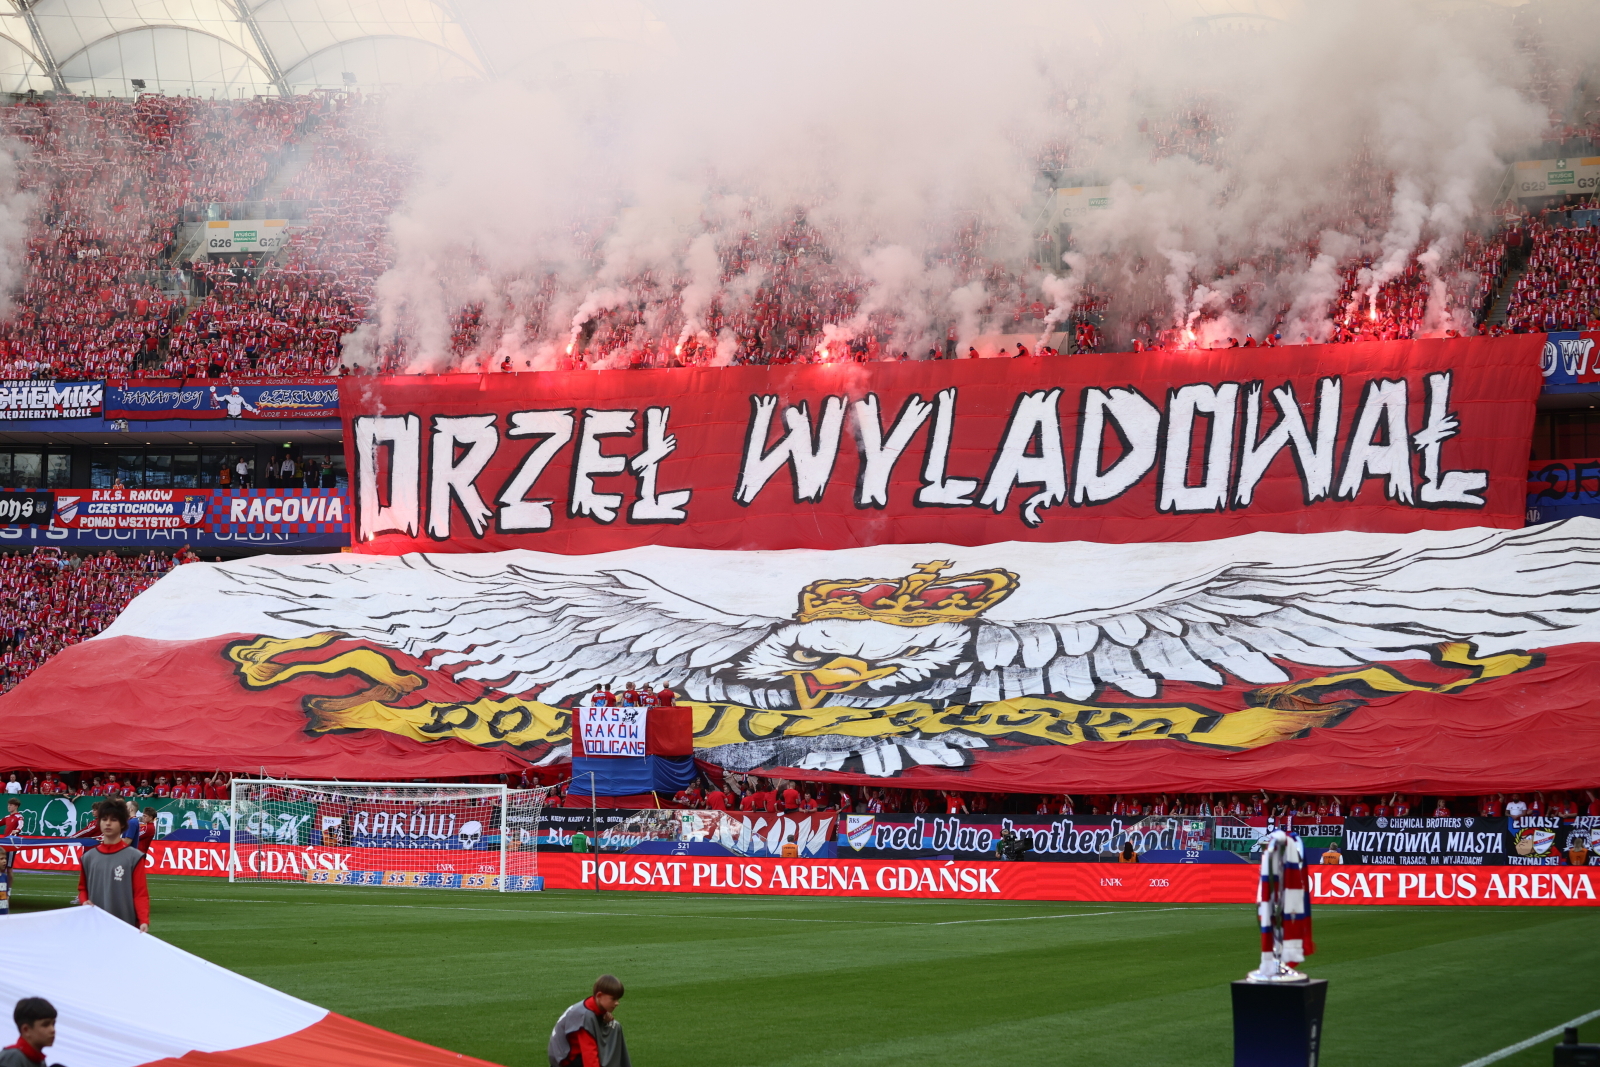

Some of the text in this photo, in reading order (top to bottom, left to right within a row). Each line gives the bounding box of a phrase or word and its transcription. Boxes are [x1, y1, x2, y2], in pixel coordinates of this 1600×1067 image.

[1521, 181, 1546, 192] G29
[210, 238, 232, 248] G26
[260, 238, 281, 247] G27
[3, 380, 56, 388] WROGOWIE
[0, 384, 103, 409] CHEMIK
[122, 390, 204, 410] FANATYCY
[0, 407, 92, 420] KĘDZIERZYN-KOŹLE
[733, 370, 1489, 528] WYLĄDOWAŁ
[354, 406, 692, 541] ORZEŁ
[92, 488, 173, 500] R.K.S. RAKÓW
[88, 503, 174, 514] CZĘSTOCHOWA
[230, 498, 343, 522] RACOVIA
[80, 516, 180, 528] PONAD WSZYSTKO
[588, 708, 620, 722] RKS
[586, 722, 638, 738] RAKÓW
[1390, 818, 1462, 828] CHEMICAL BROTHERS
[1513, 816, 1560, 828] ŁUKASZ
[875, 816, 925, 850] red
[933, 816, 992, 852] blue
[1221, 826, 1252, 838] BLUE
[1318, 825, 1342, 836] 1992
[546, 827, 573, 847] Blu
[1346, 829, 1503, 854] WIZYTÓWKA MIASTA
[1220, 840, 1248, 852] CITY
[160, 848, 242, 872] ARENA
[249, 845, 351, 874] GDAŃSK
[1362, 854, 1368, 864] W
[1430, 856, 1440, 864] NA
[1442, 856, 1483, 864] WYJAZDACH!
[1508, 856, 1542, 865] TRZYMAJ
[312, 872, 328, 882] STS
[335, 872, 351, 882] STS
[358, 872, 374, 884] STS
[389, 872, 406, 884] STS
[413, 872, 430, 886] STS
[436, 872, 454, 886] STS
[468, 874, 484, 886] STS
[492, 875, 509, 887] SS
[517, 876, 534, 888] STS
[581, 860, 1001, 893] POLSAT PLUS ARENA GDAŃSK
[1149, 878, 1170, 887] 2026
[1308, 872, 1598, 900] LSAT PLUS ARENA
